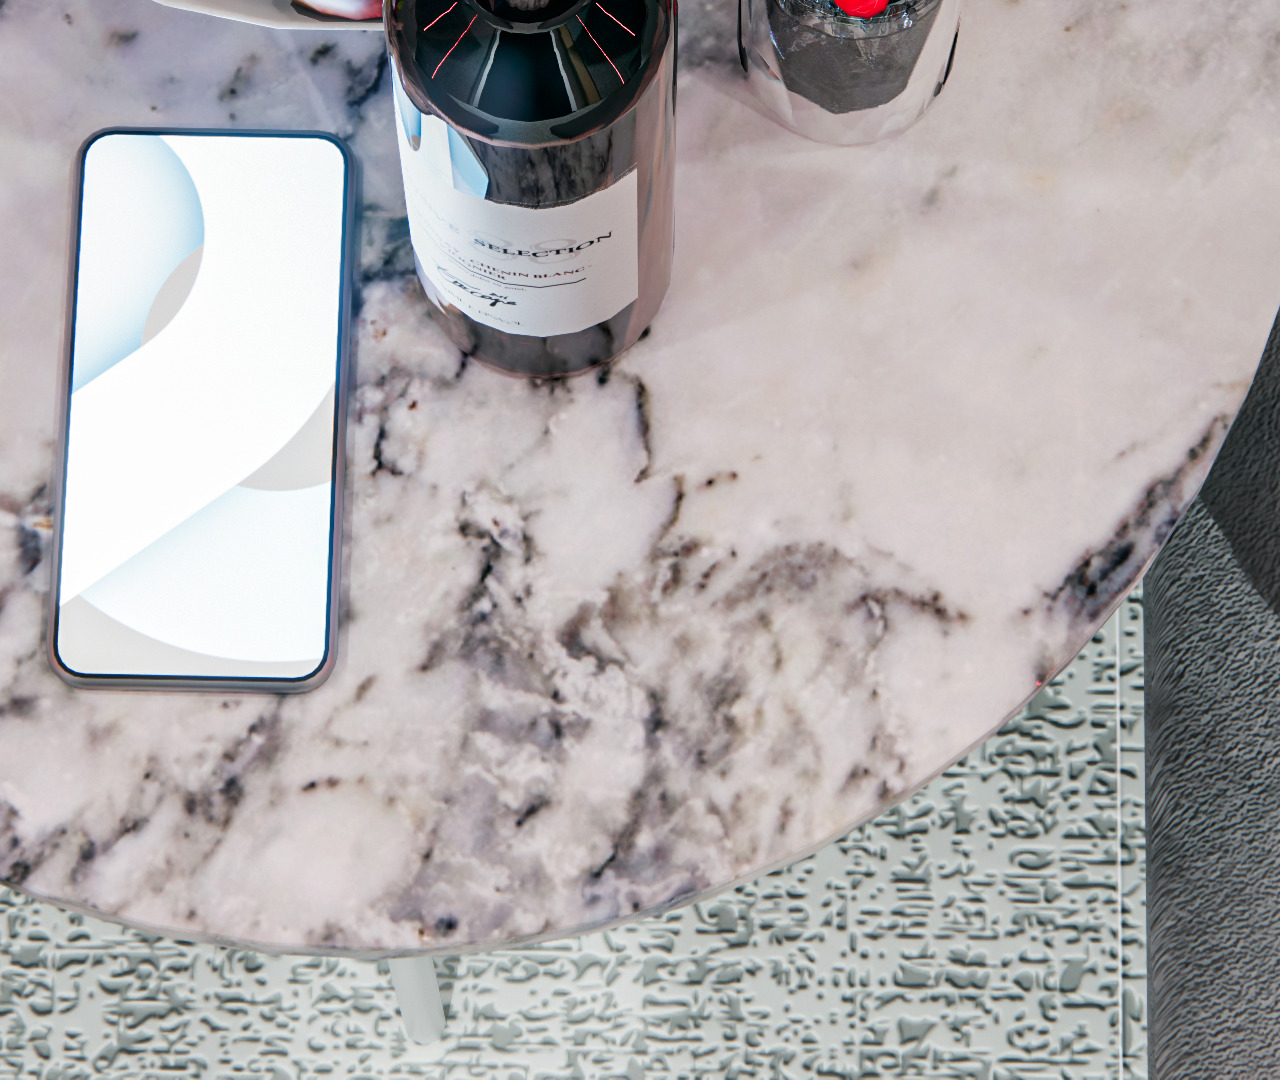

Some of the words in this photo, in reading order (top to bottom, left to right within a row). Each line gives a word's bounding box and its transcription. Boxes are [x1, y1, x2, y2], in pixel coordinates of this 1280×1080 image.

[473, 230, 612, 258] SELECTION
[470, 259, 529, 278] CHENIN
[533, 266, 586, 279] BLANC
